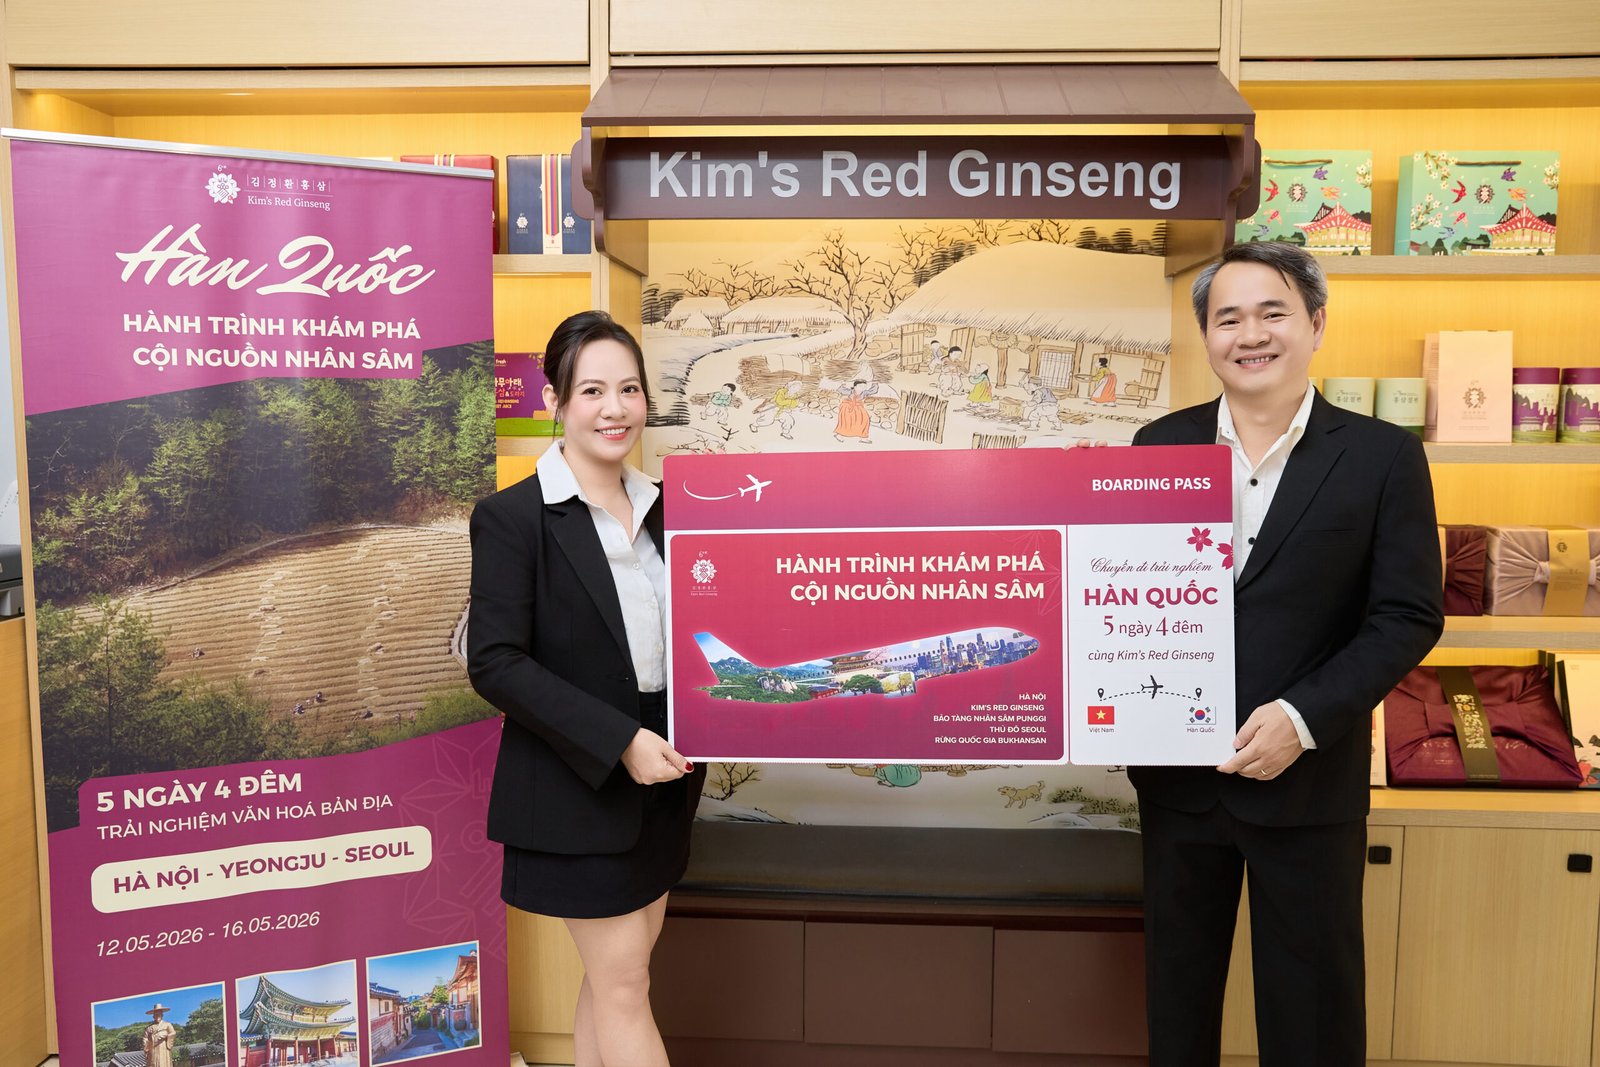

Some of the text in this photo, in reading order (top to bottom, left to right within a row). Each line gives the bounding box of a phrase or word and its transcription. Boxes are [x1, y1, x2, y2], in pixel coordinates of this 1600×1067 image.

[650, 150, 800, 198] Kim's
[822, 151, 926, 197] Red
[248, 196, 331, 212] Kim's Red Ginseng
[116, 223, 435, 297] Hàn Quốc
[124, 310, 420, 338] HÀNH TRÌNH KHÁM PHÁ
[133, 341, 412, 371] CỘI NGUỒN NHÂN SÂM
[1093, 478, 1211, 491] BOARDING PASS
[777, 551, 1044, 573] HÀNH TRÌNH KHÁM PHÁ
[1136, 561, 1148, 571] đi
[1172, 559, 1213, 577] nghiệm
[791, 577, 1044, 605] CỘI NGUỒN NHÂN SÂM
[1085, 580, 1218, 609] HÀN QUỐC
[1104, 616, 1202, 637] 5 ngày 4 đêm
[1088, 650, 1214, 663] cùng Kim's Red Ginseng
[1019, 692, 1046, 701] HÀ NỘI
[958, 735, 982, 744] QUỐC
[97, 770, 301, 812] 5 NGÀY 4 ĐÊM
[97, 795, 393, 839] TRẢI NGHIỆM VĂN HOÁ BẢN ĐỊA
[114, 871, 150, 893] HÀ
[157, 865, 198, 890] NỘI
[219, 852, 327, 879] YEONGJU
[345, 841, 414, 862] SEOUL
[97, 928, 203, 956] 12.05.2026
[223, 911, 320, 938] 16.05.2026
